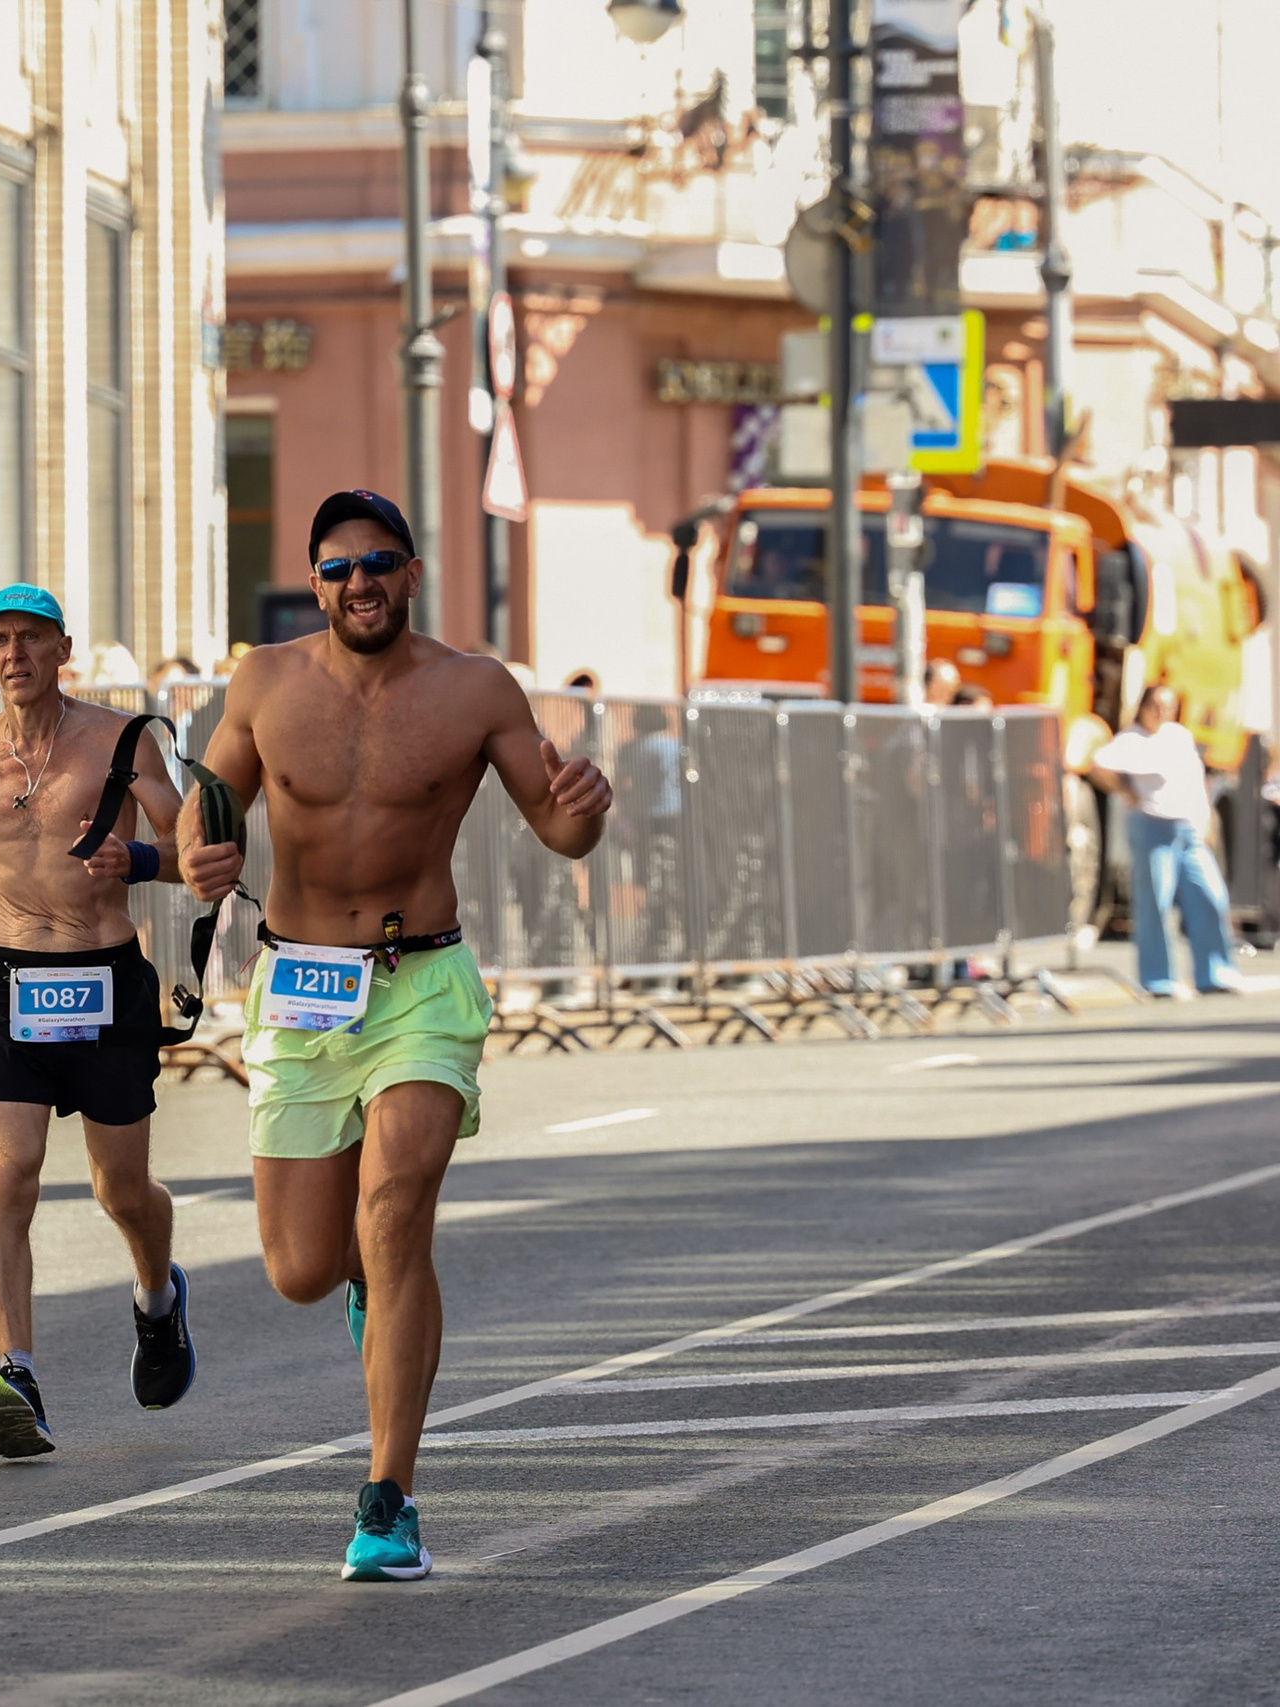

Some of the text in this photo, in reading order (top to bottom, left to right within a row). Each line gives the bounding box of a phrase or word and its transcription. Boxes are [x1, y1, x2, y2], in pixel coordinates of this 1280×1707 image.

[294, 967, 340, 994] 1211
[346, 980, 354, 989] B
[30, 987, 91, 1009] 1087
[287, 1000, 338, 1010] #GalaxyMarathon
[21, 1029, 29, 1037] C
